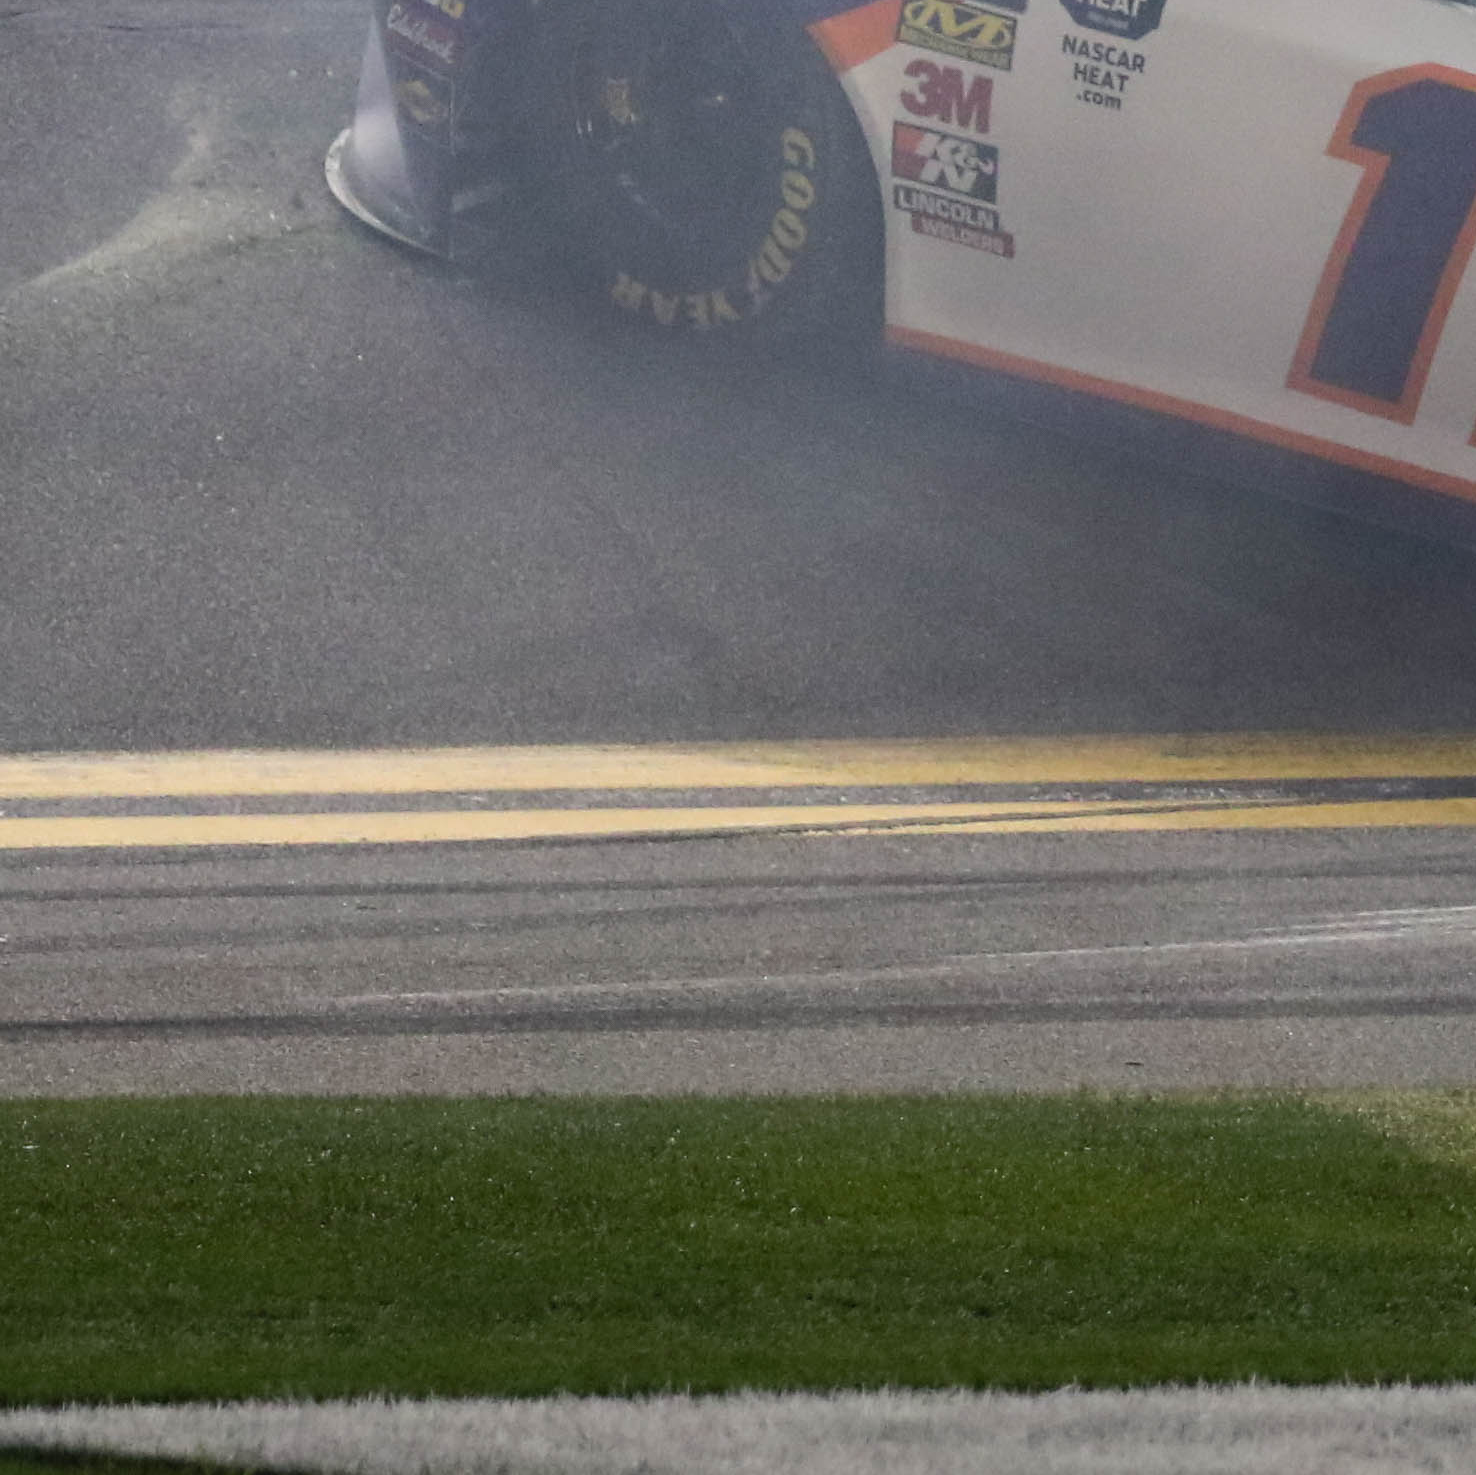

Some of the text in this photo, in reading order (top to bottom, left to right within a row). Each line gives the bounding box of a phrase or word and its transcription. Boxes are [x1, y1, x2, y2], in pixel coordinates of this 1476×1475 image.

[1061, 33, 1147, 74] NASCAR
[899, 58, 994, 134] 3M
[1072, 62, 1131, 93] HEAT
[1075, 89, 1123, 111] .com
[897, 186, 1000, 229] LINCOLN
